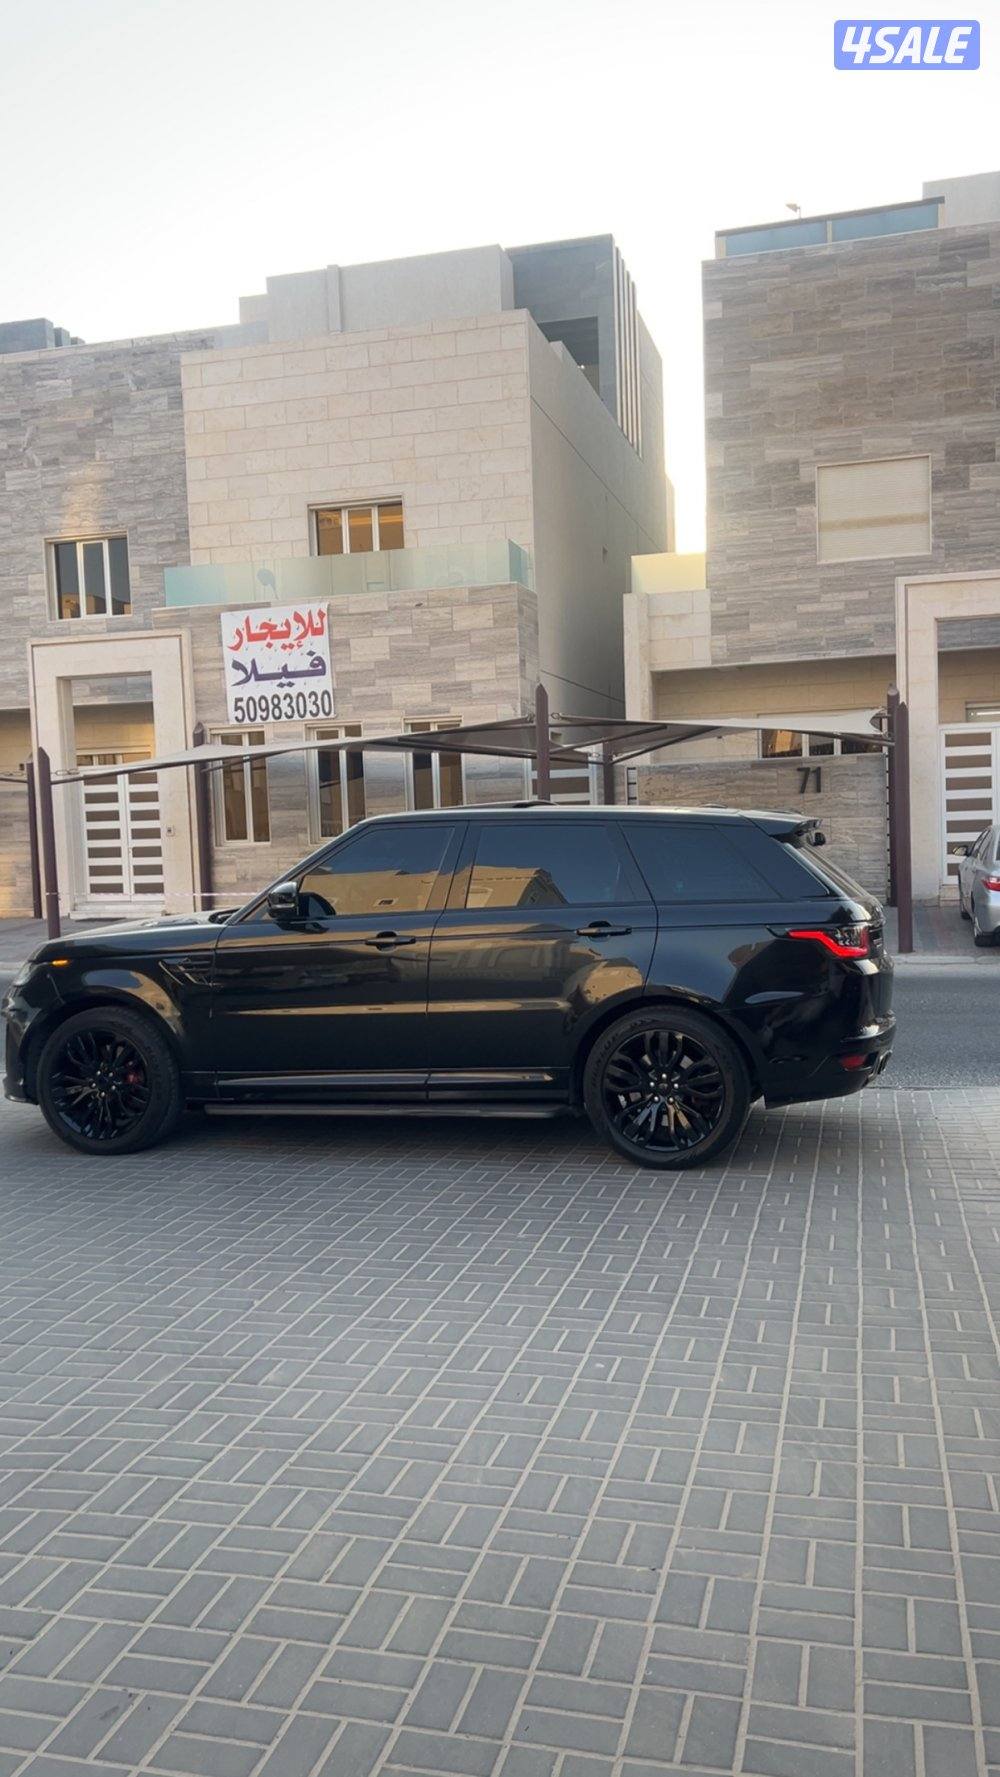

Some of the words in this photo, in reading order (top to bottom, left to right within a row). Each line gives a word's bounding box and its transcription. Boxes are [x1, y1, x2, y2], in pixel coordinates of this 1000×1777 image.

[227, 609, 326, 651] للإيجار
[231, 650, 326, 688] فيلا
[233, 689, 332, 723] 50983030
[796, 766, 821, 794] 71
